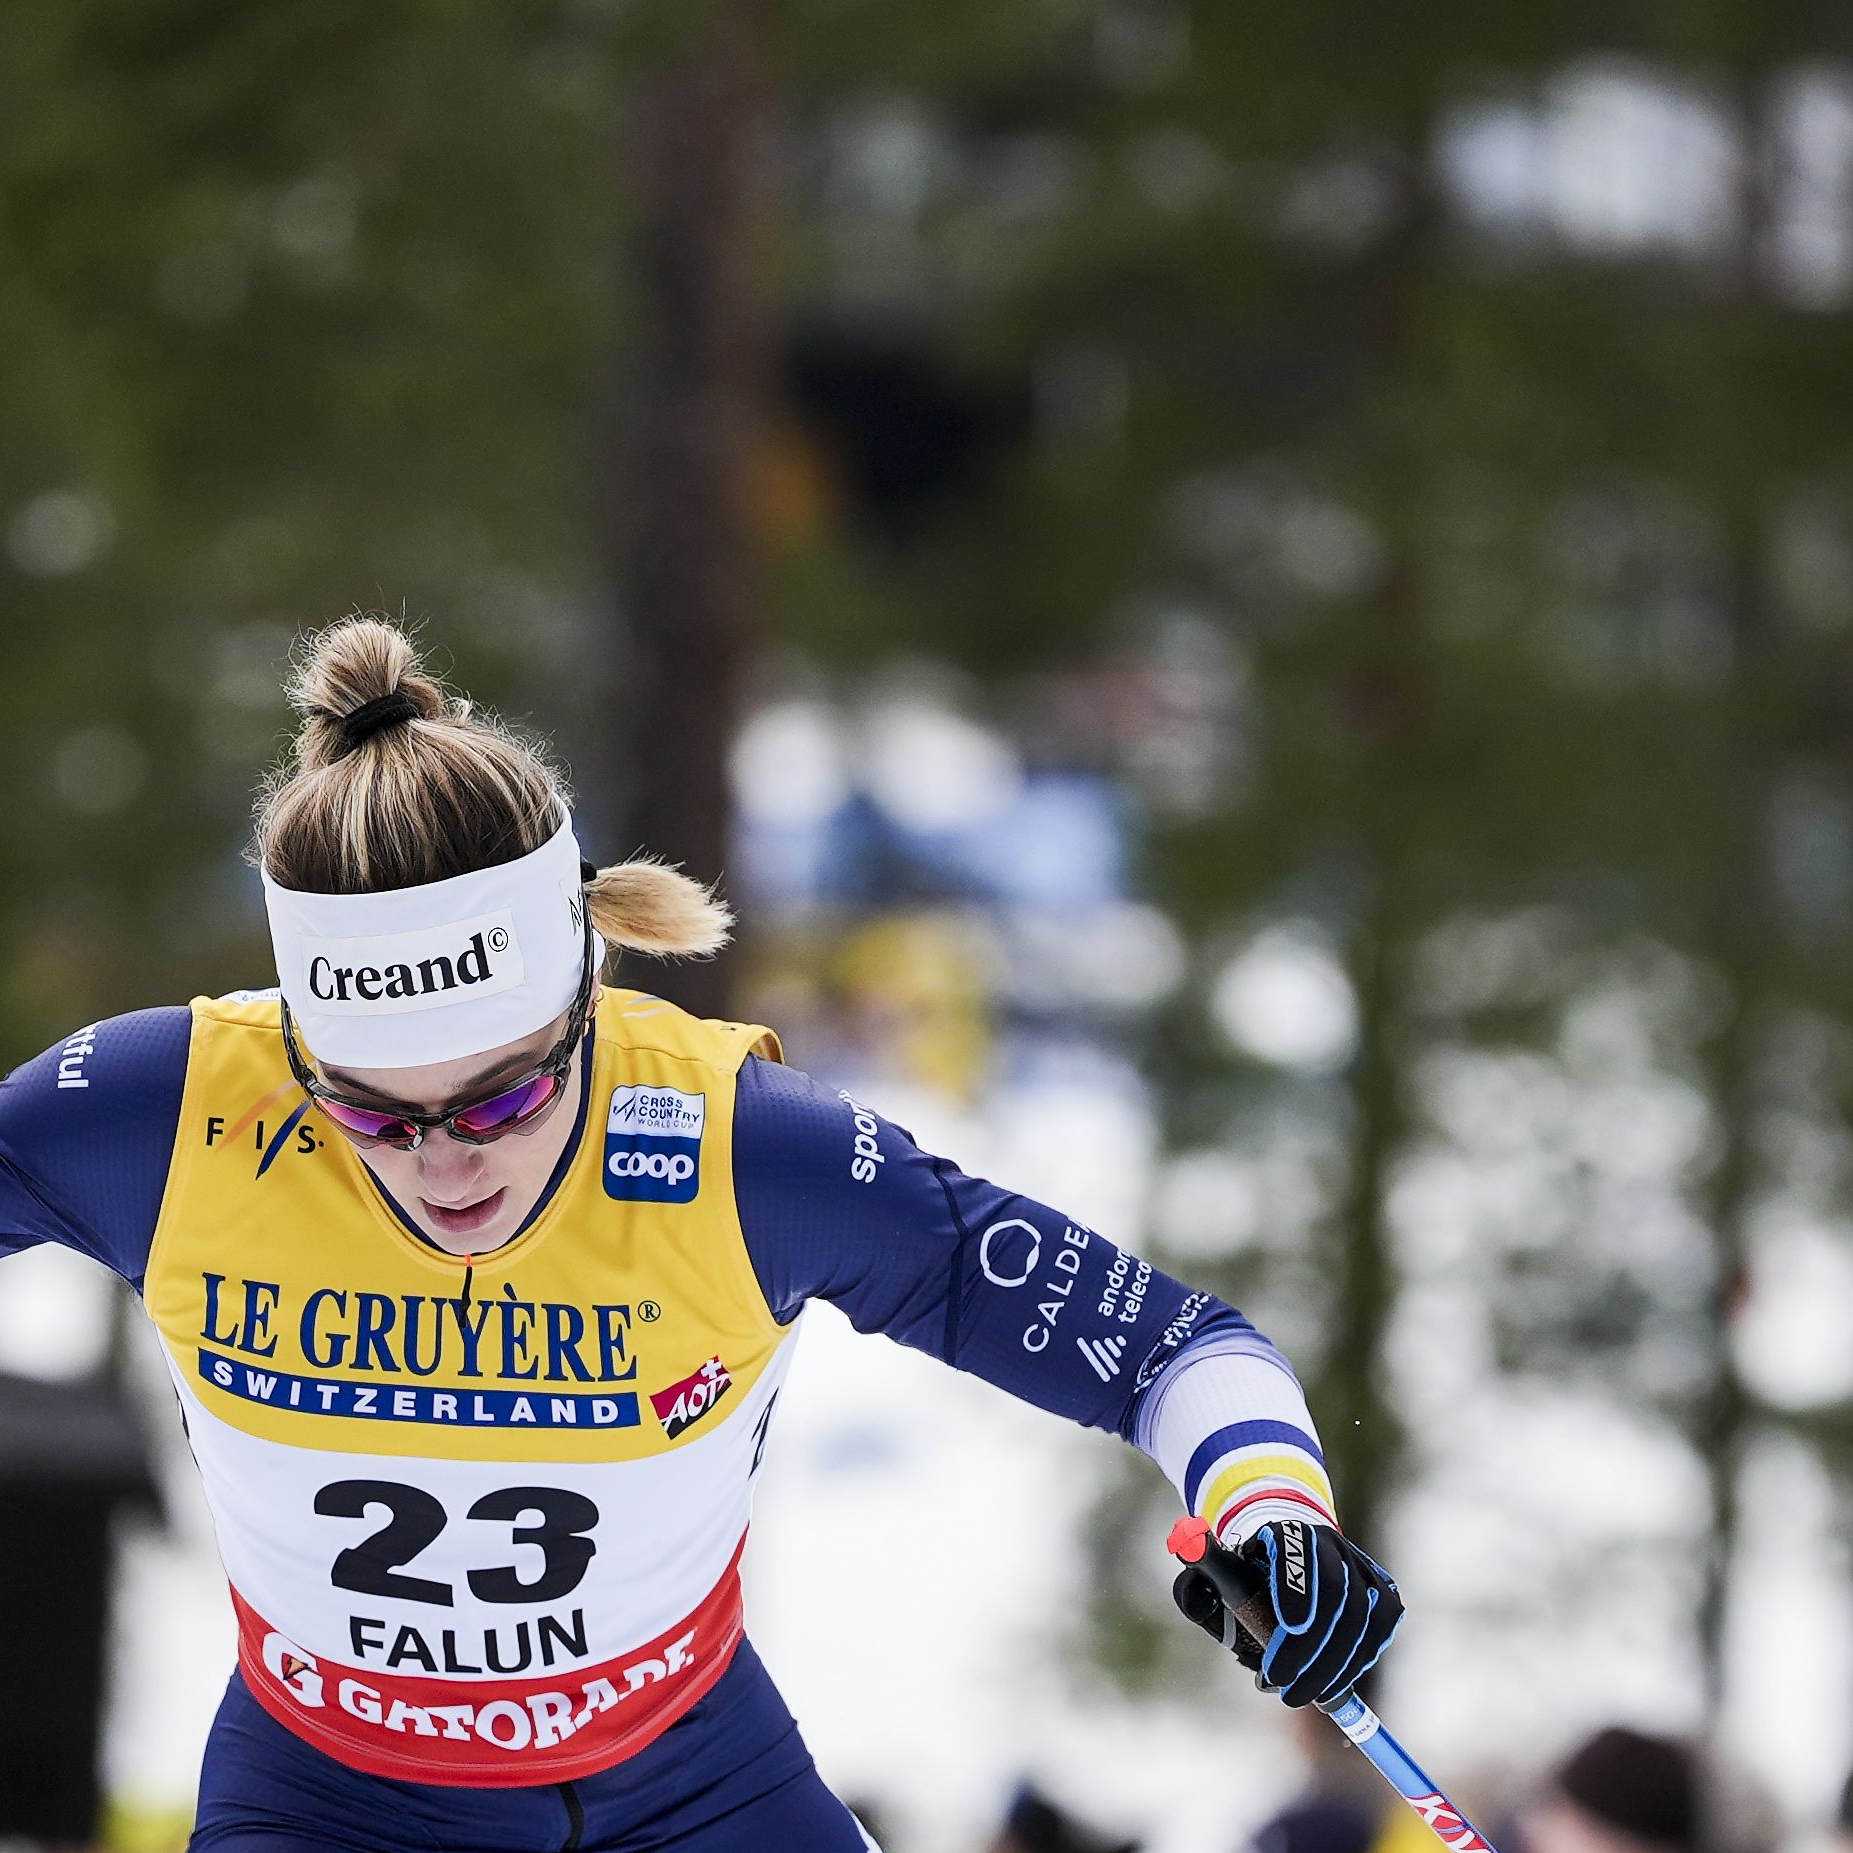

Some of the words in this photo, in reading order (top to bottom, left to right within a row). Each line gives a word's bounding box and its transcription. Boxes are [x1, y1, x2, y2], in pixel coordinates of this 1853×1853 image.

[638, 1106, 700, 1123] COUNTRY
[640, 1095, 684, 1108] CROSS
[673, 1120, 695, 1130] CUP
[608, 1151, 695, 1186] coop
[199, 1272, 280, 1358] LE
[1022, 1217, 1091, 1353] CALDE
[213, 1359, 621, 1426] SWITZERLAND
[313, 1479, 600, 1608] 23
[349, 1608, 590, 1674] FALUN
[337, 1627, 698, 1751] GATORADE
